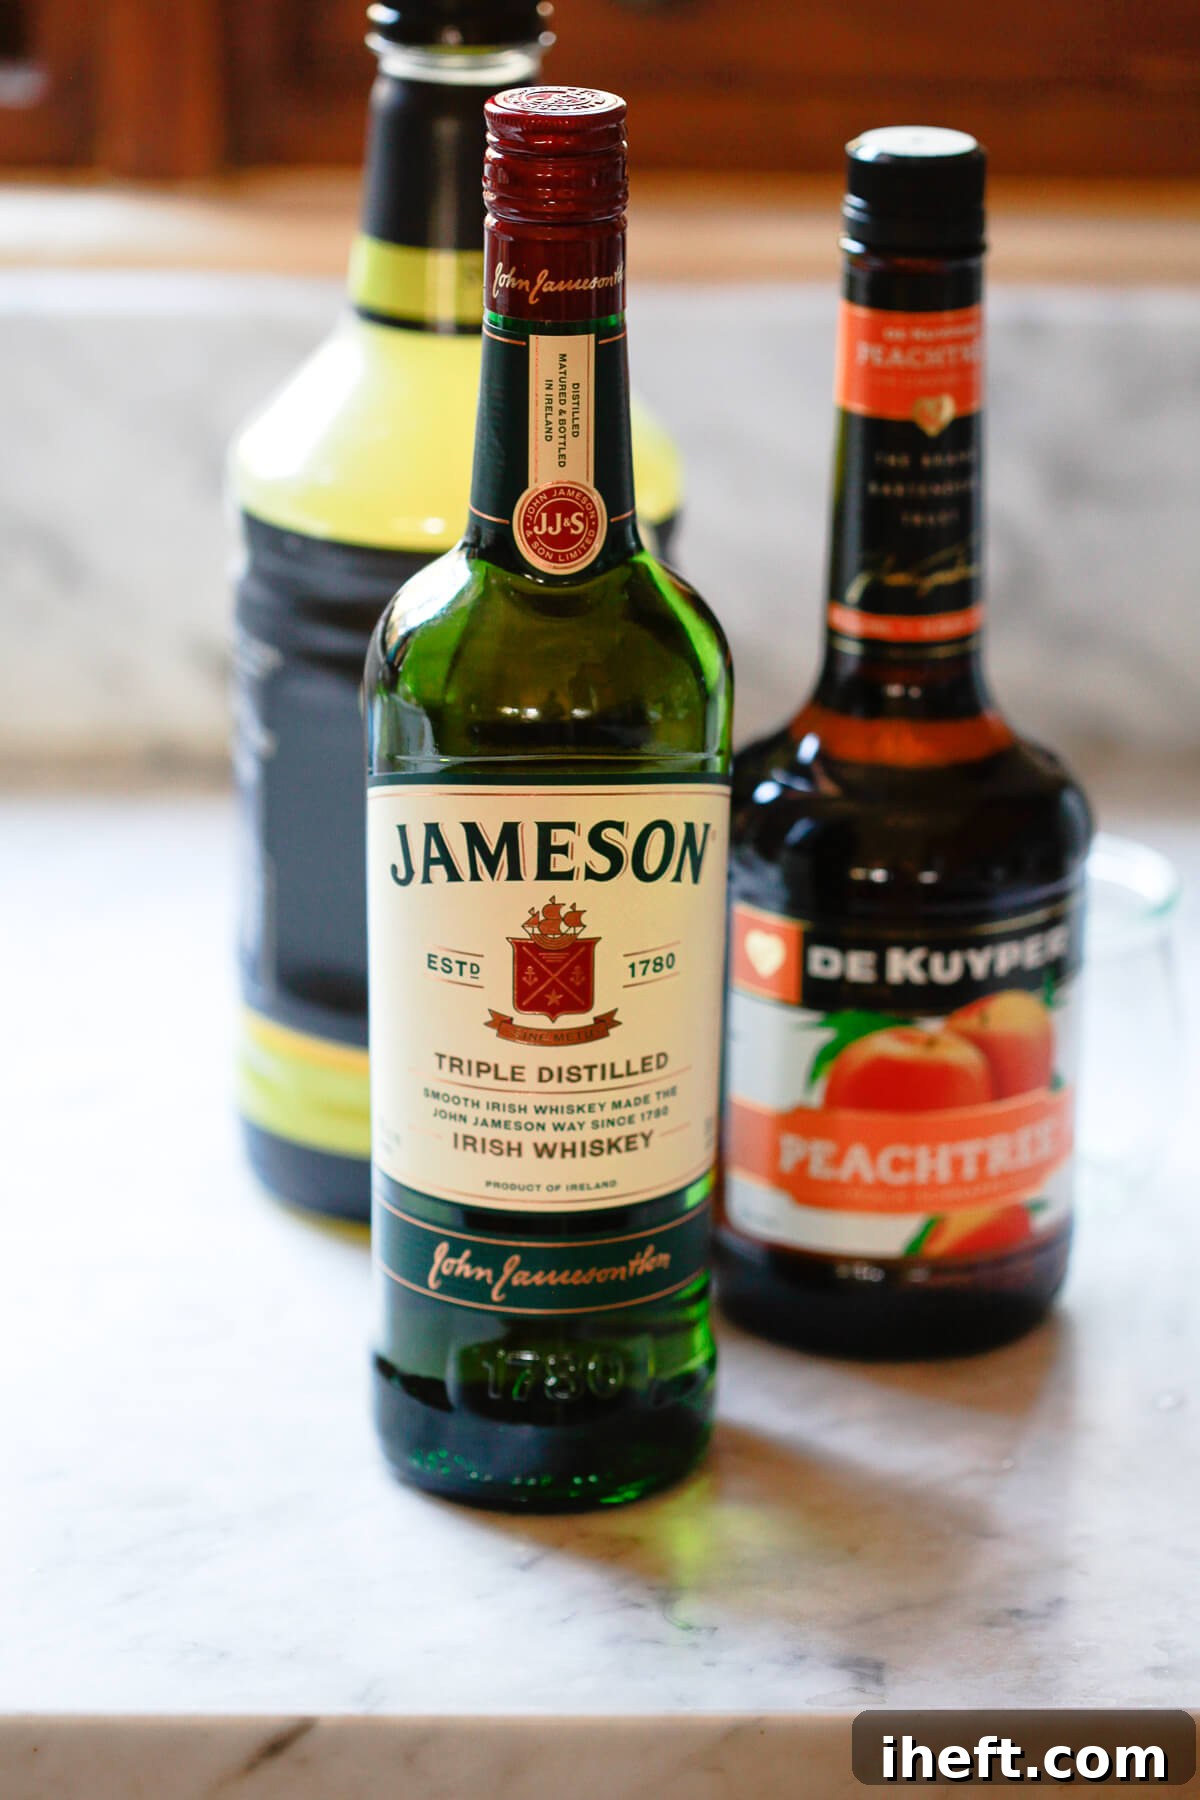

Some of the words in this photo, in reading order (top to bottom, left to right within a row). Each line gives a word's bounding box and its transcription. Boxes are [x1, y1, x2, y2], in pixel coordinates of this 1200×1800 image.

[544, 379, 553, 390] IN
[558, 353, 567, 406] MATURED
[544, 393, 553, 442] IRELAND
[558, 408, 567, 416] &
[571, 382, 580, 438] DISTILLED
[557, 418, 567, 468] BOTTLED
[525, 493, 548, 521] JOHN
[552, 488, 597, 520] JAMESON
[533, 512, 585, 536] JJ&S
[531, 541, 554, 561] SON
[558, 529, 596, 562] LIMITED
[390, 819, 711, 886] JAMESON
[628, 952, 676, 978] 1780
[806, 944, 878, 982] DE
[434, 1052, 526, 1083] TRIPLE
[537, 1052, 669, 1084] DISTILLED
[423, 1087, 480, 1110] SMOOTH
[486, 1101, 527, 1115] IRISH
[534, 1102, 606, 1116] WHISKEY
[611, 1094, 650, 1111] MADE
[655, 1085, 678, 1101] THE
[433, 1107, 468, 1125] JOHN
[473, 1116, 546, 1133] JAMESON
[553, 1120, 586, 1133] WAY
[591, 1113, 636, 1131] SINCE
[453, 1131, 523, 1159] IRISH
[533, 1129, 655, 1160] WHISKEY
[485, 1180, 542, 1193] PRODUCT
[546, 1184, 561, 1193] OF
[565, 1179, 618, 1193] IRELAND
[427, 1241, 493, 1291] John
